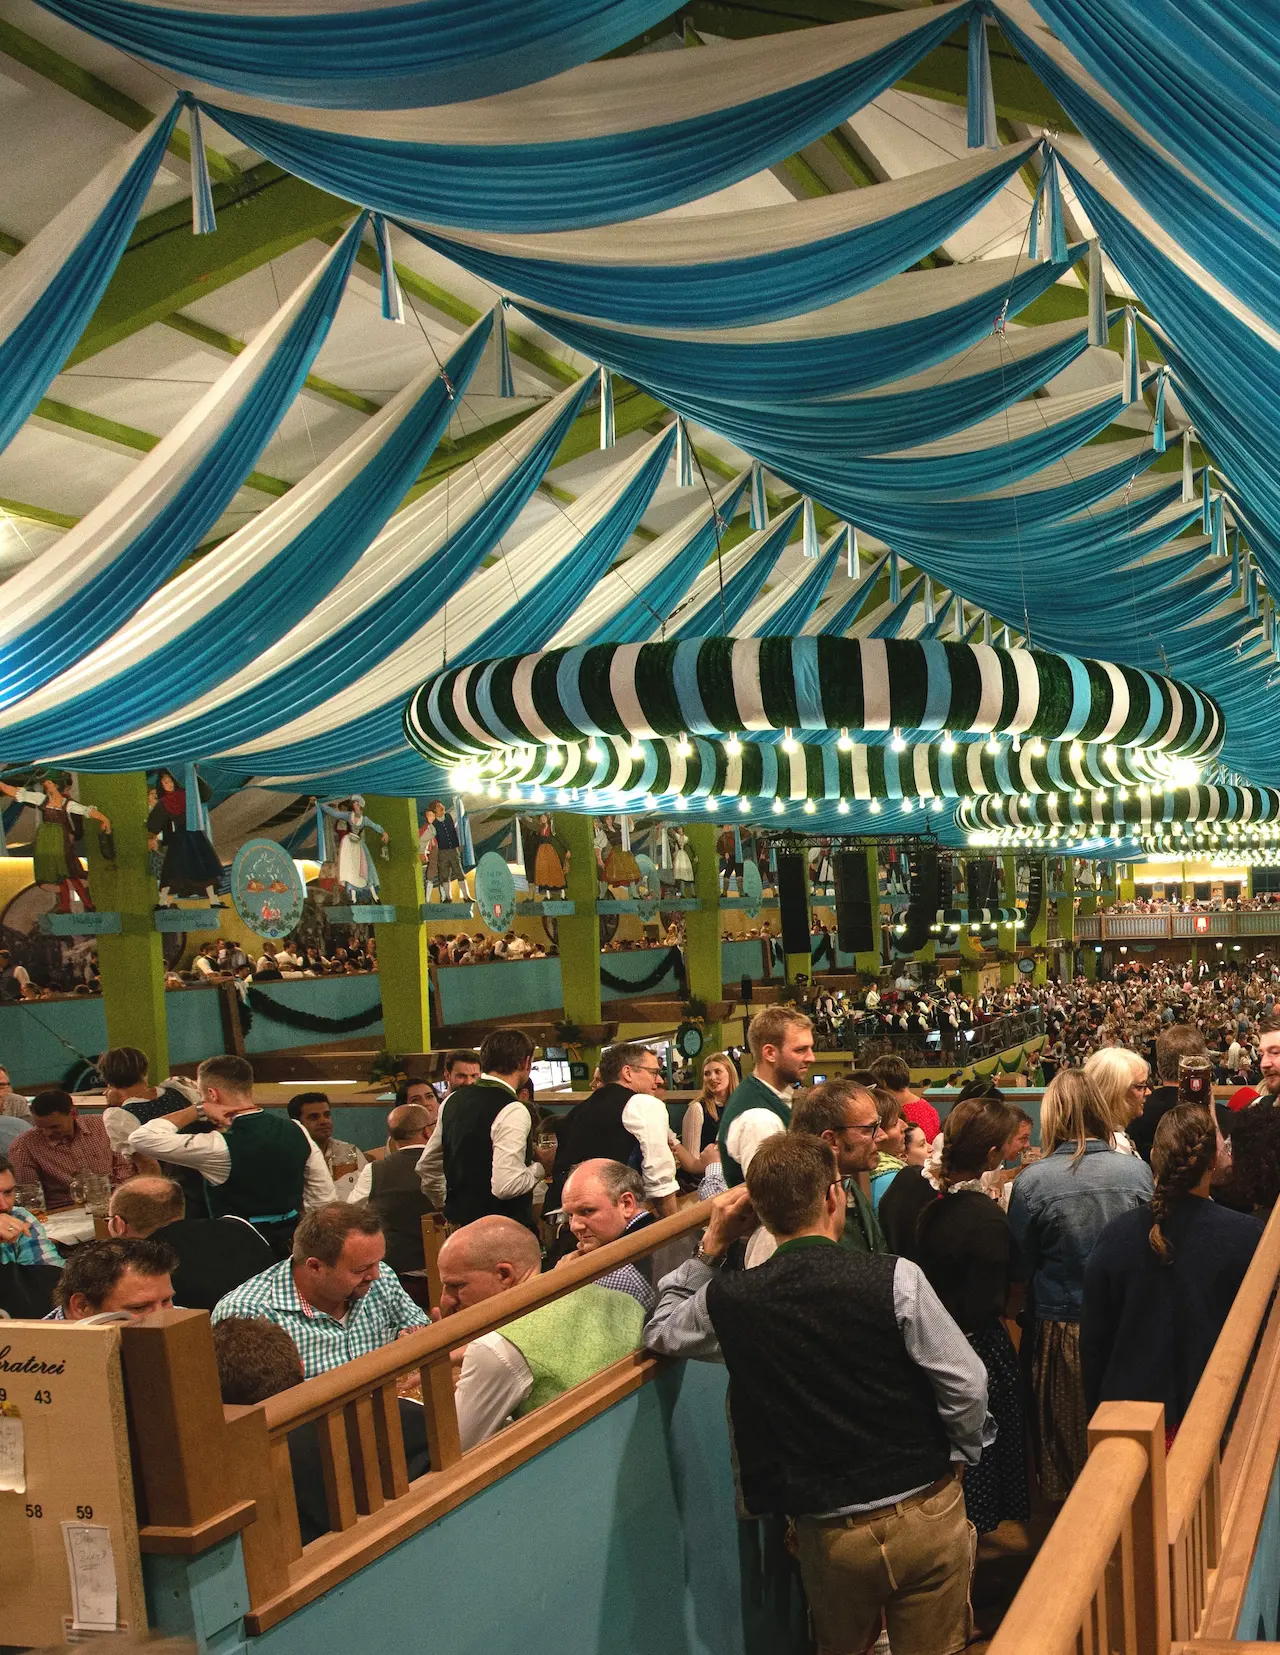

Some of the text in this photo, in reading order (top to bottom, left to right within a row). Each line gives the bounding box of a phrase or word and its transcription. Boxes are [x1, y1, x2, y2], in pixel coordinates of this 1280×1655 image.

[34, 1390, 52, 1405] 43
[25, 1504, 93, 1520] 58 59
